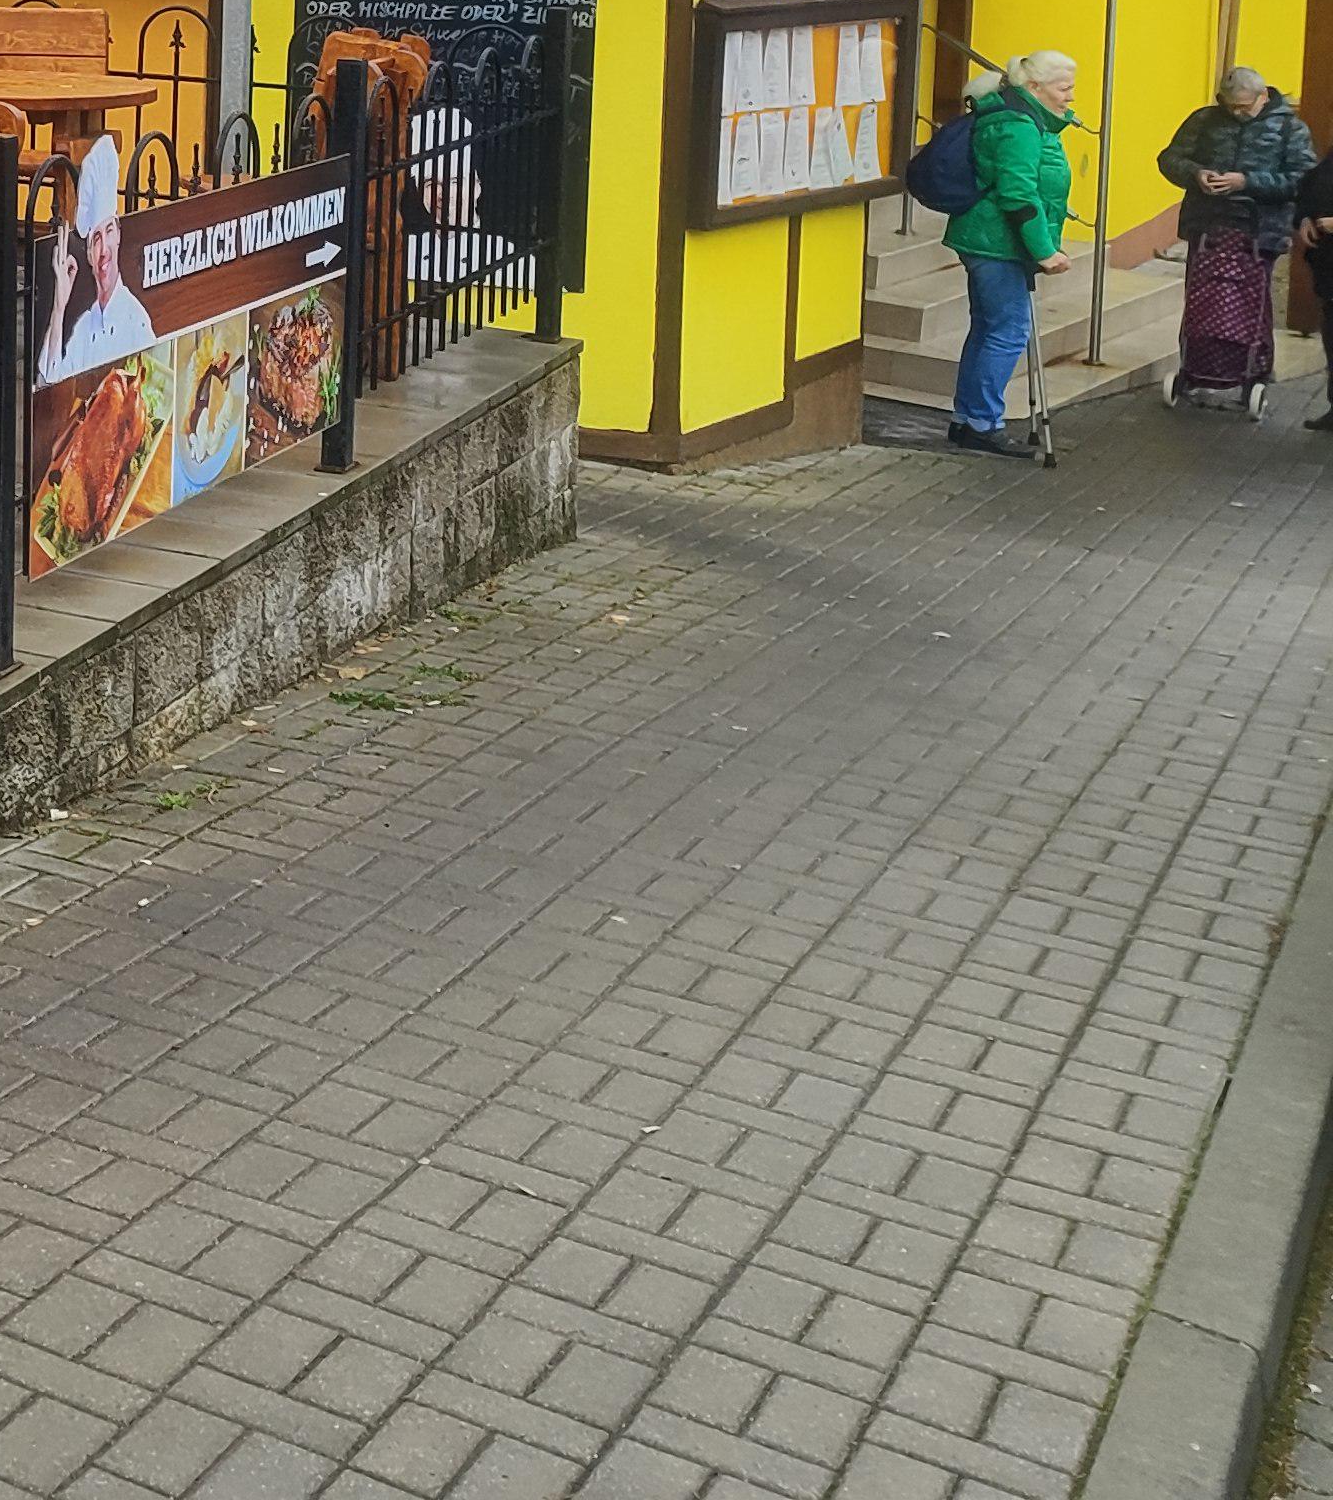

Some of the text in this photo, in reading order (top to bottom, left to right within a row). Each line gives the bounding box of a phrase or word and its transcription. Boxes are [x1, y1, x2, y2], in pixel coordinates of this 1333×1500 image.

[306, 0, 356, 18] ODER
[460, 4, 514, 23] ODER
[142, 186, 346, 289] HERZLICH WILKOMMEN
